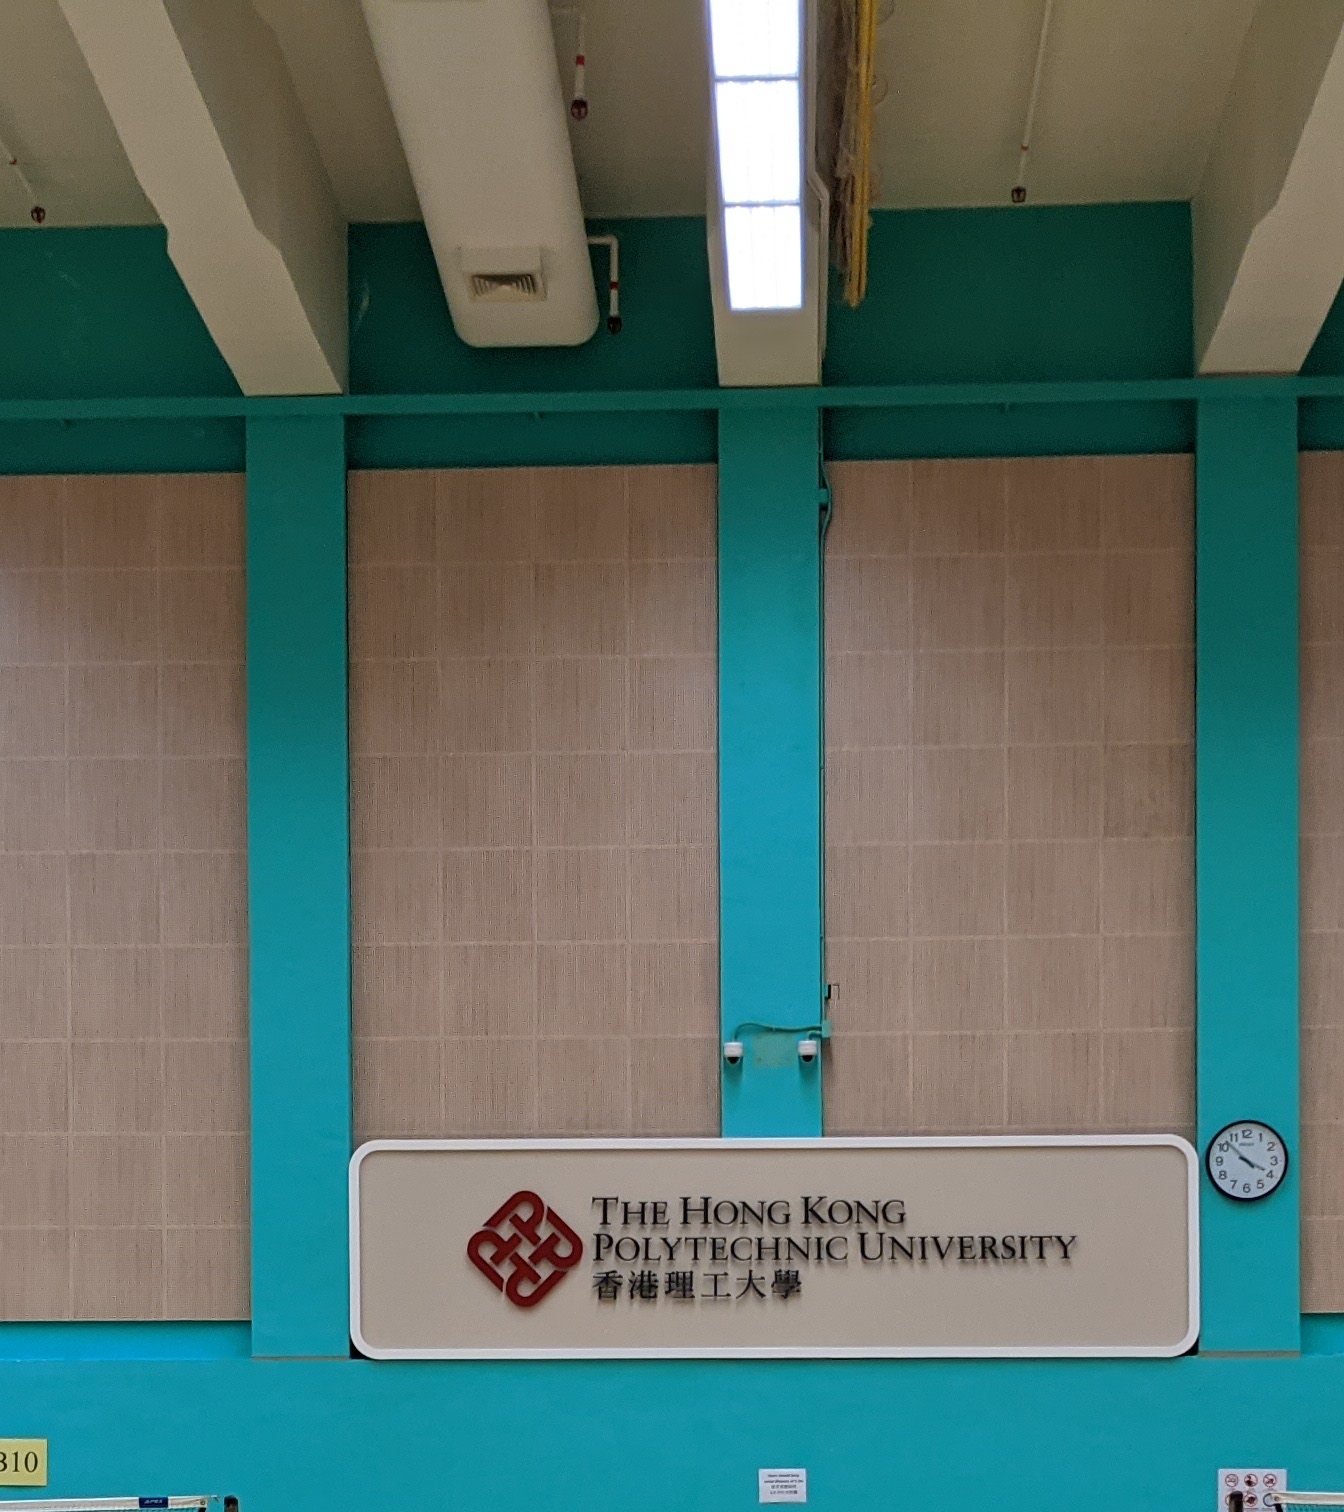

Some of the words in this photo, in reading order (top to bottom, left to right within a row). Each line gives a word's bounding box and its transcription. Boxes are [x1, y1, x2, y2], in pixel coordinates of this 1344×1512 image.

[1229, 1133, 1239, 1143] 11
[1242, 1128, 1253, 1139] 12
[1258, 1132, 1264, 1143] 1
[1217, 1141, 1229, 1153] 10
[1267, 1141, 1276, 1152] 2
[1216, 1156, 1223, 1167] 9
[1270, 1156, 1278, 1166] 3
[1218, 1170, 1227, 1180] 8
[1266, 1169, 1274, 1179] 4
[1230, 1180, 1238, 1190] 7
[1242, 1183, 1251, 1194] 6
[1256, 1179, 1265, 1190] 5
[592, 1196, 671, 1225] THE
[679, 1196, 791, 1225] HONG
[800, 1195, 906, 1225] KONG
[592, 1232, 849, 1262] POLYTECHNIC
[858, 1231, 1077, 1261] UNIVERSITY
[591, 1269, 803, 1300] 香港理工大學
